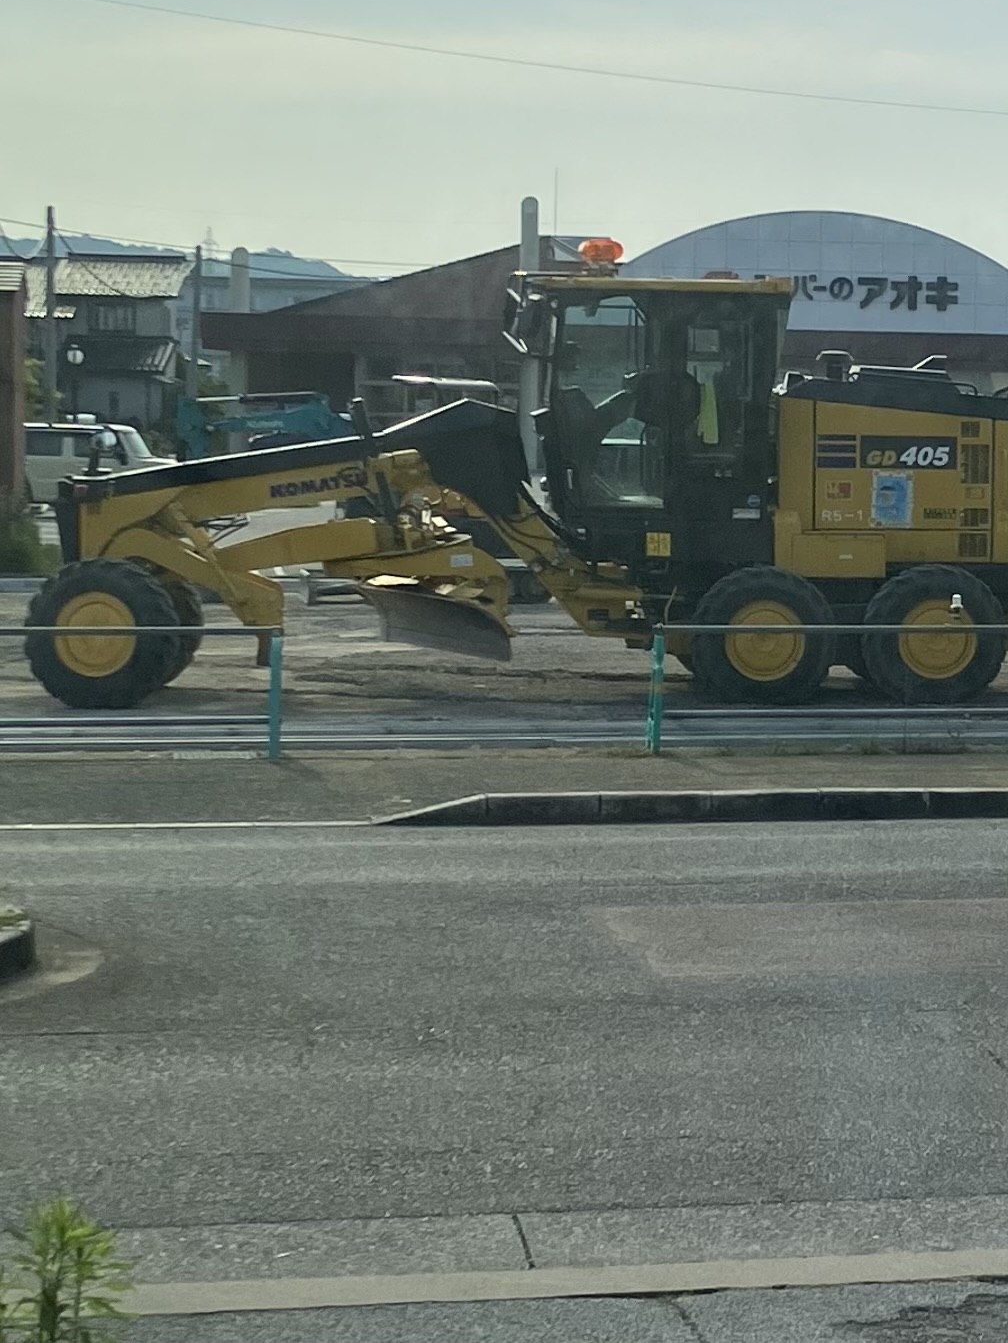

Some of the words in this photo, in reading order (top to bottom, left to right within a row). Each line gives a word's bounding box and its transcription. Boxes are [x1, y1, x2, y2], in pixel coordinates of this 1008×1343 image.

[754, 274, 959, 311] パーのアオキ
